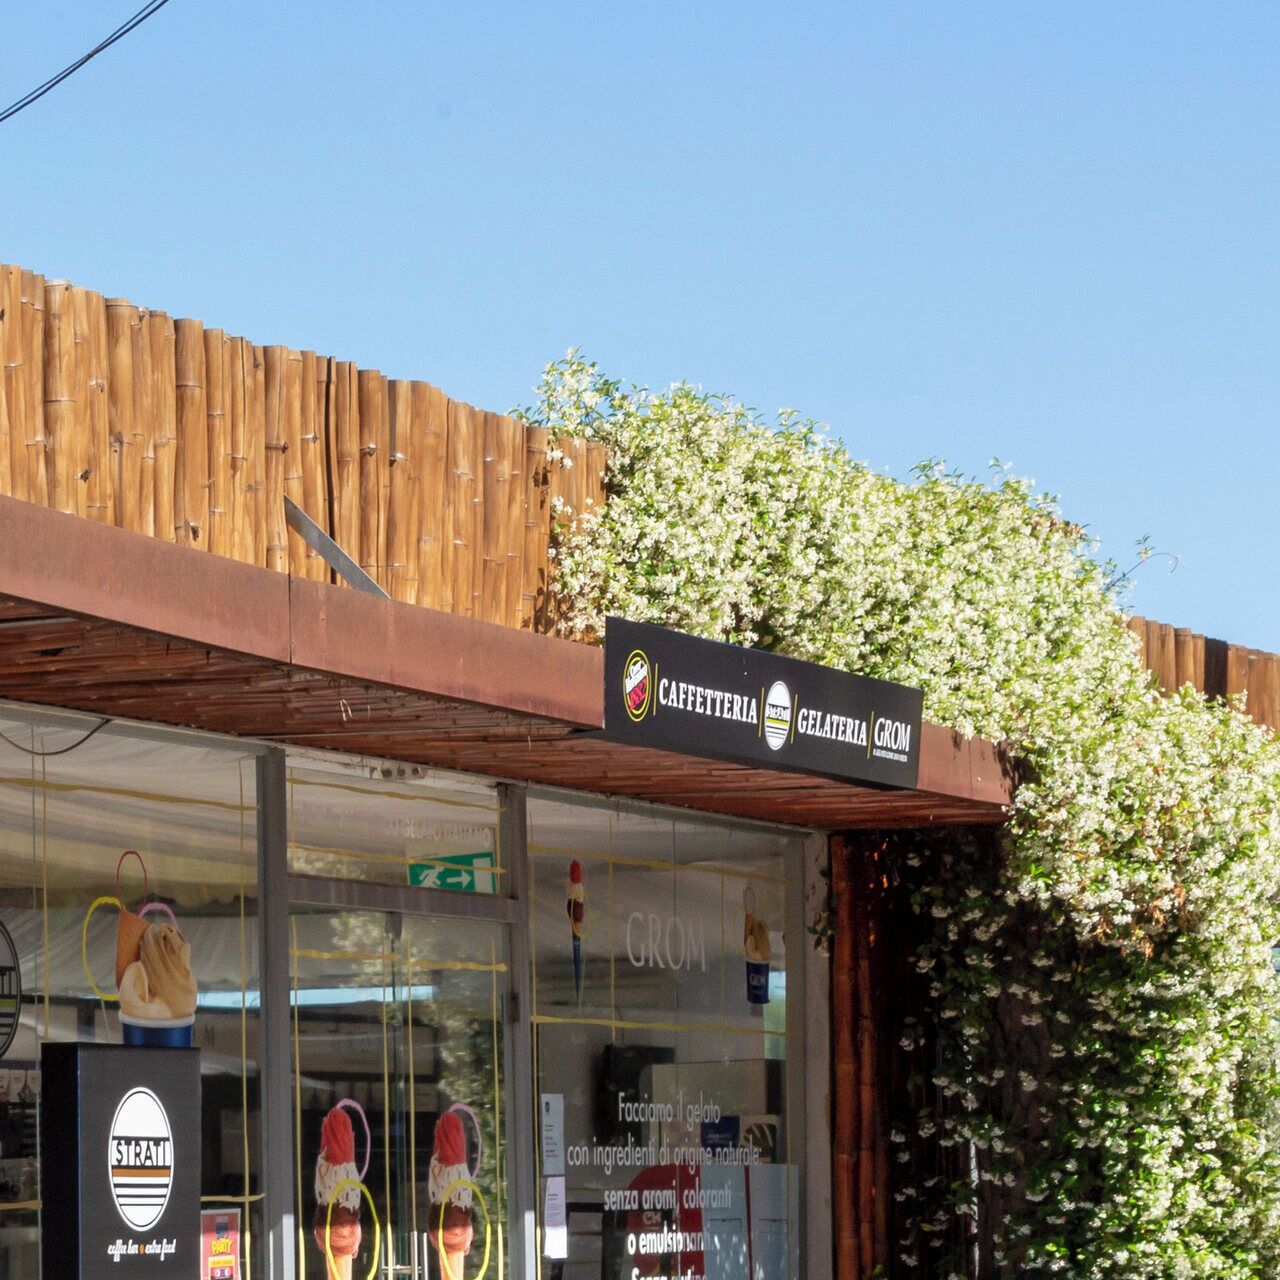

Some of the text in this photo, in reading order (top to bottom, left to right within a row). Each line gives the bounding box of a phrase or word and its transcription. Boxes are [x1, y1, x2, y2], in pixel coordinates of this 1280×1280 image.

[659, 678, 758, 724] CAFFETTERIA
[798, 708, 867, 746] GELATERIA
[874, 717, 911, 752] GROM
[626, 911, 706, 972] GROM
[618, 1091, 674, 1123] Facciamo
[686, 1090, 721, 1131] gelato
[116, 1139, 166, 1166] STRATI
[567, 1144, 589, 1166] con
[593, 1132, 656, 1175] ingredienti
[659, 1136, 670, 1165] di
[673, 1137, 713, 1174] origine
[604, 1177, 732, 1214] senza aromi, coloranti
[627, 1233, 637, 1256] o
